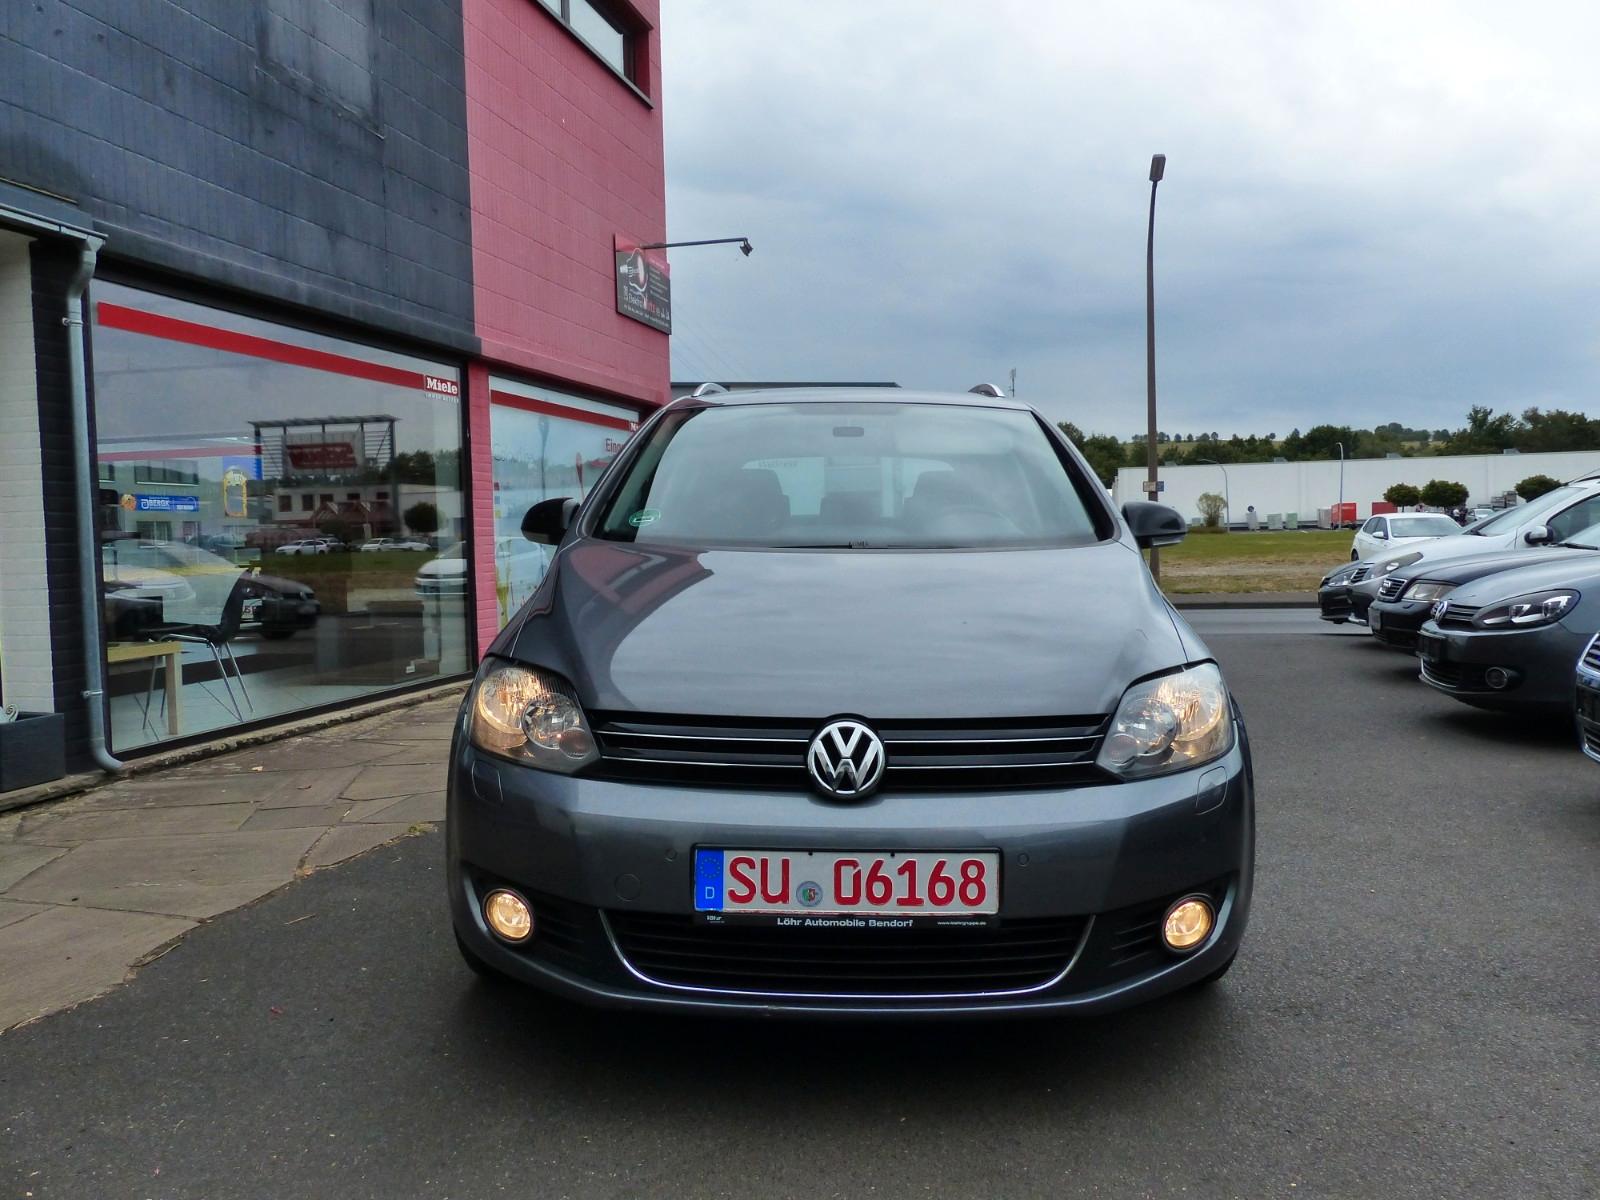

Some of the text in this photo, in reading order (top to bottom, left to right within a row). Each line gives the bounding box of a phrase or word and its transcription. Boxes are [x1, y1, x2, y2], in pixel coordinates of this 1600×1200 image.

[426, 377, 458, 395] Miele
[705, 857, 987, 906] D SU 06168
[777, 917, 914, 927] Löhr Automobile Bendorf
